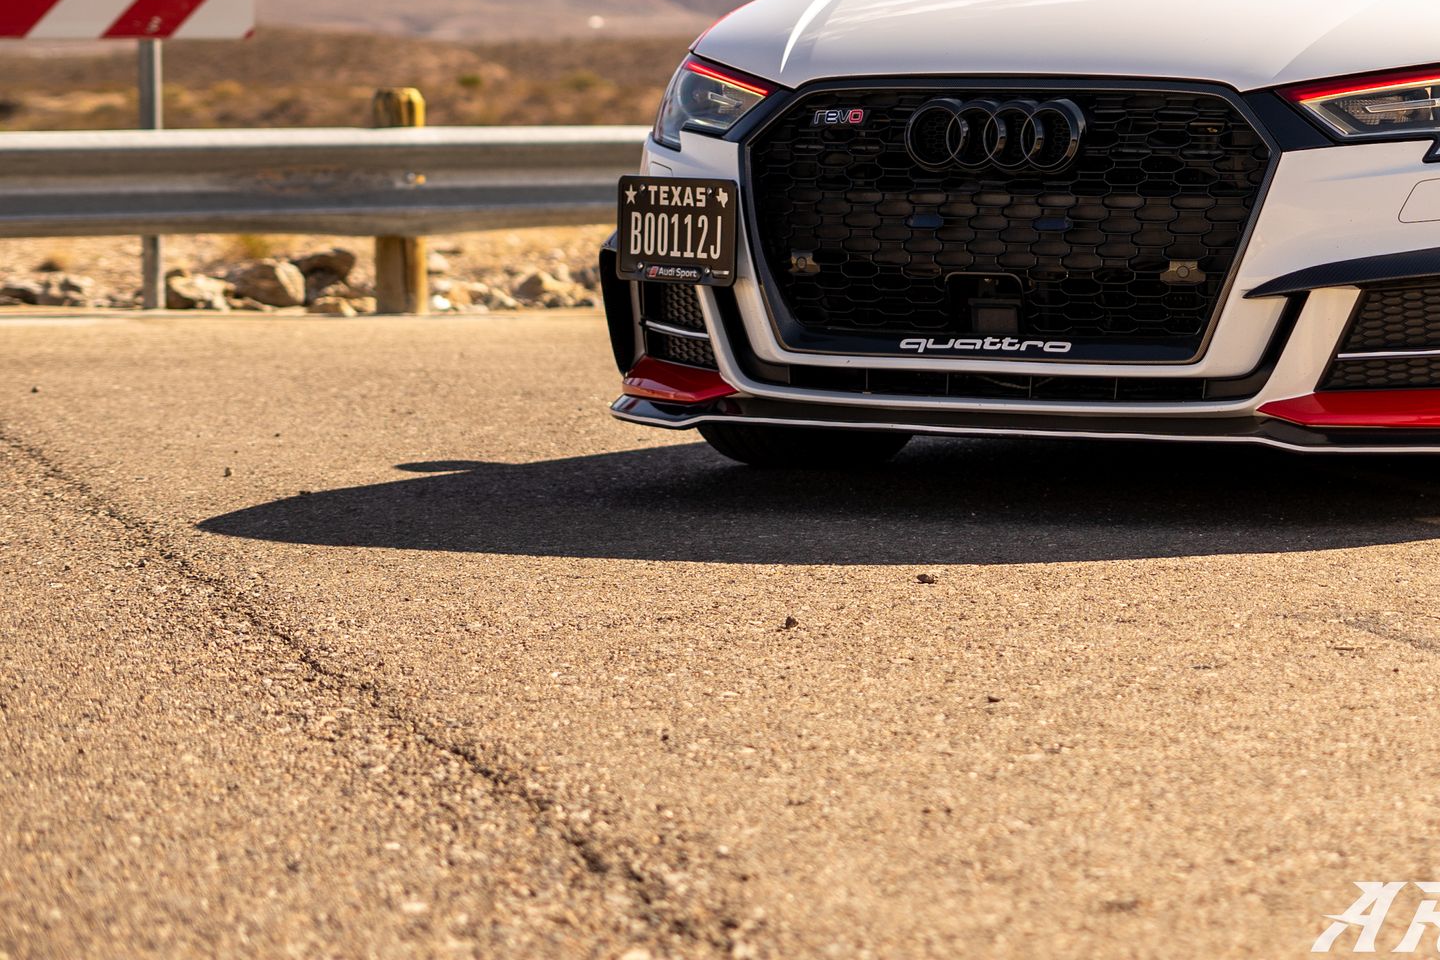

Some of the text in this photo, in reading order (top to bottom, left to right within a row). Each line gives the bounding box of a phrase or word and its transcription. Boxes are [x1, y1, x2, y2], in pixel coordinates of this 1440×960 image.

[813, 109, 864, 124] revo
[648, 185, 707, 207] TEXAS
[658, 267, 697, 279] Audi Sport
[899, 336, 1072, 353] quattro
